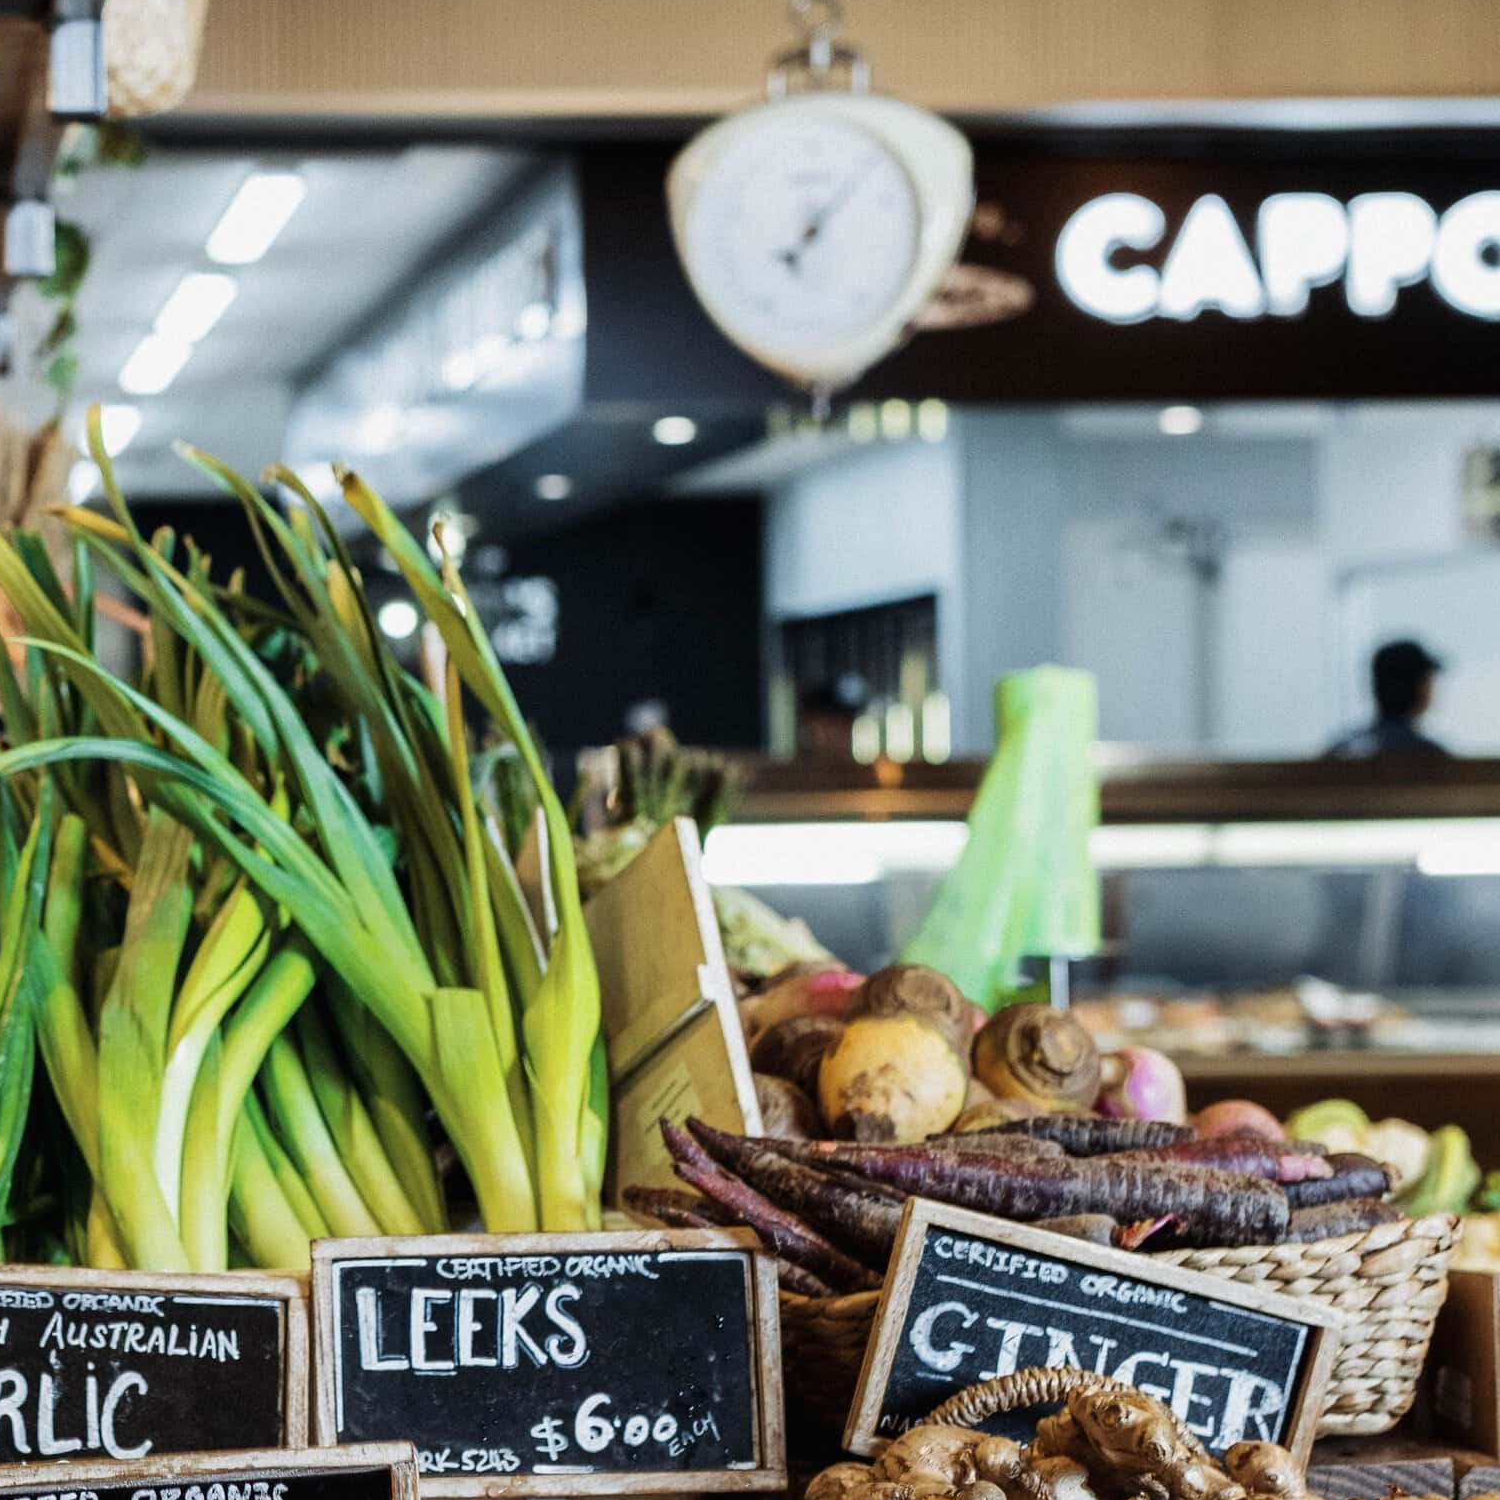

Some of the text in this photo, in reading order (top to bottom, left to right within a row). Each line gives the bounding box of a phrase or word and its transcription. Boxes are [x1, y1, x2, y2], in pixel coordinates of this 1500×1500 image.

[436, 1253, 661, 1281] CERTIFIED ORGANIC
[934, 1235, 1188, 1314] CERTIFIED ORGANIC
[62, 1292, 164, 1317] ORGANIC
[355, 1282, 590, 1375] LEEKS
